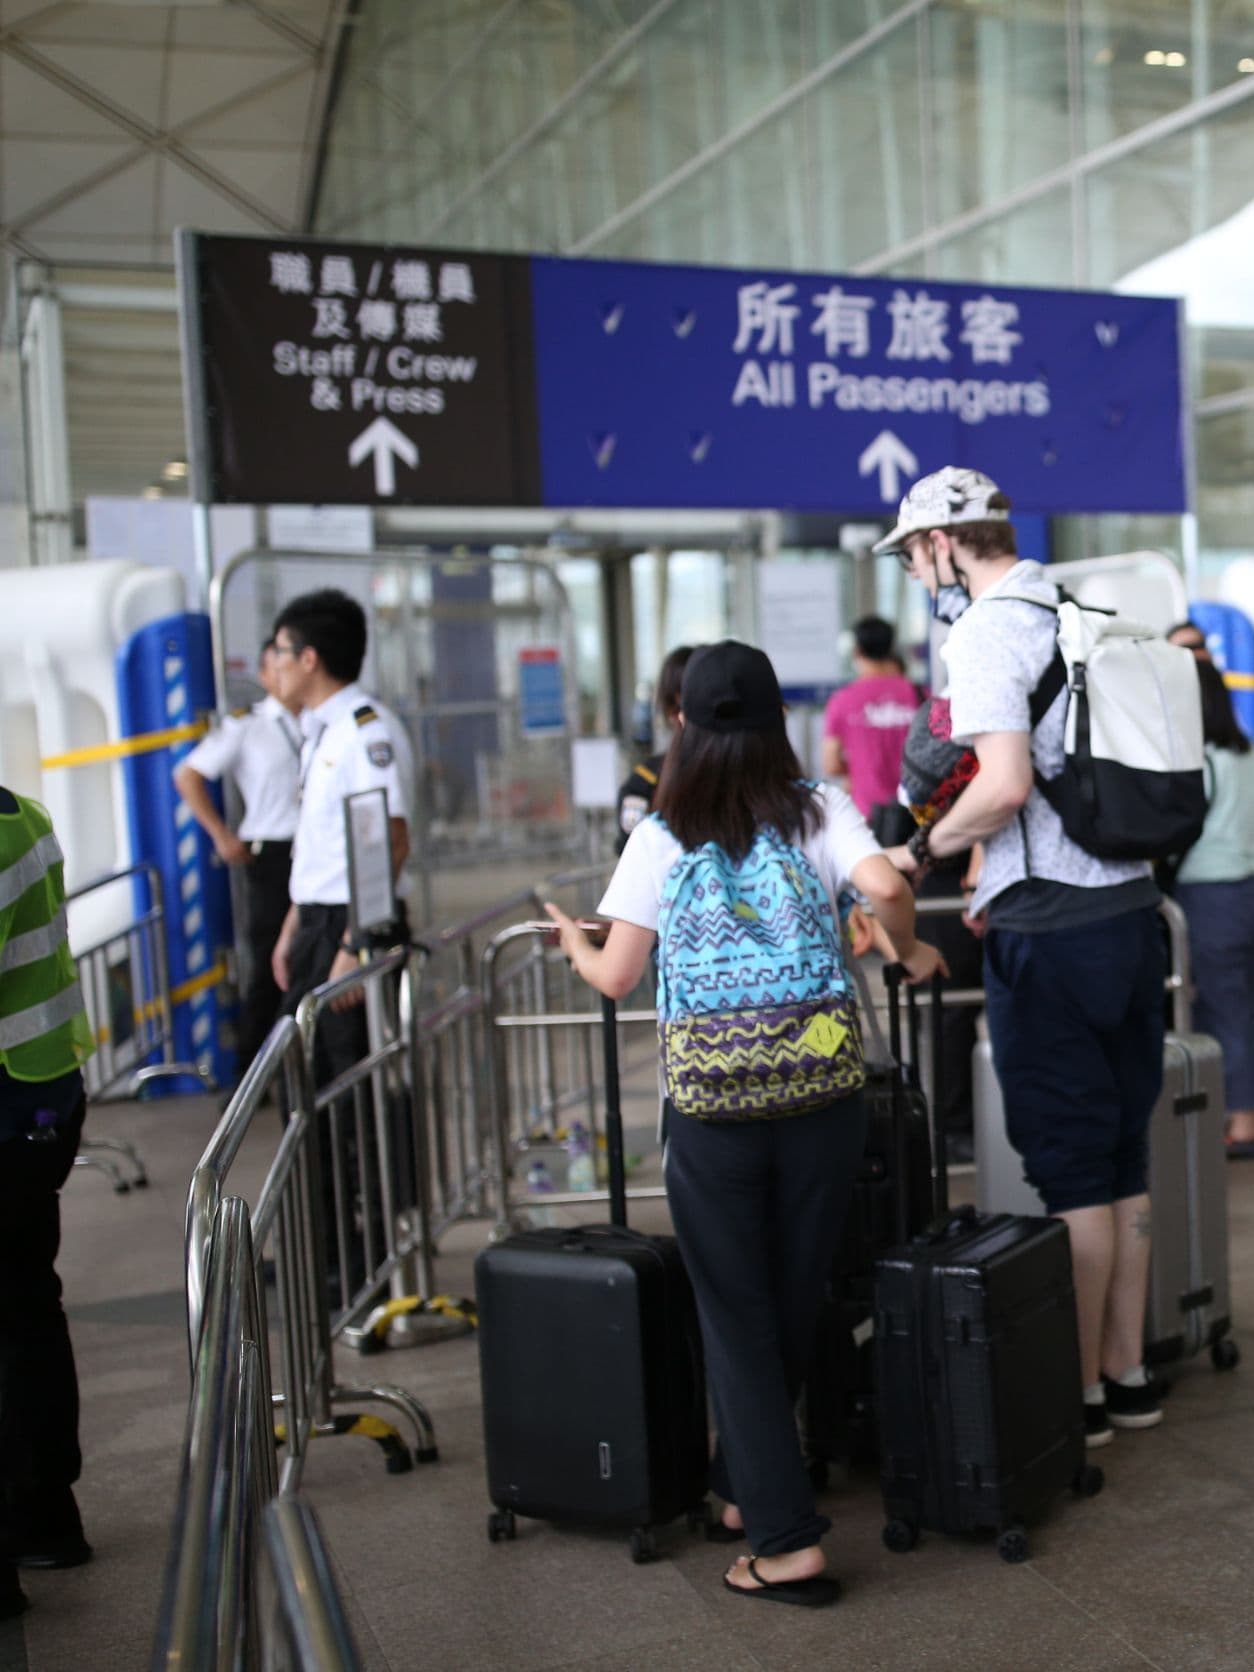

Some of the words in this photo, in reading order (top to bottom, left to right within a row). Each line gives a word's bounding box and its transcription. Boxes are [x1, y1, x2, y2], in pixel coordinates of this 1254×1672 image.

[312, 298, 444, 342] 及傳媒
[732, 281, 1022, 365] 所有旅客
[273, 340, 357, 376] Staff
[364, 346, 380, 377] /
[387, 346, 476, 383] Crew
[310, 376, 342, 411] &
[351, 378, 445, 414] Press
[732, 359, 795, 407] All
[808, 362, 1050, 424] Passengers
